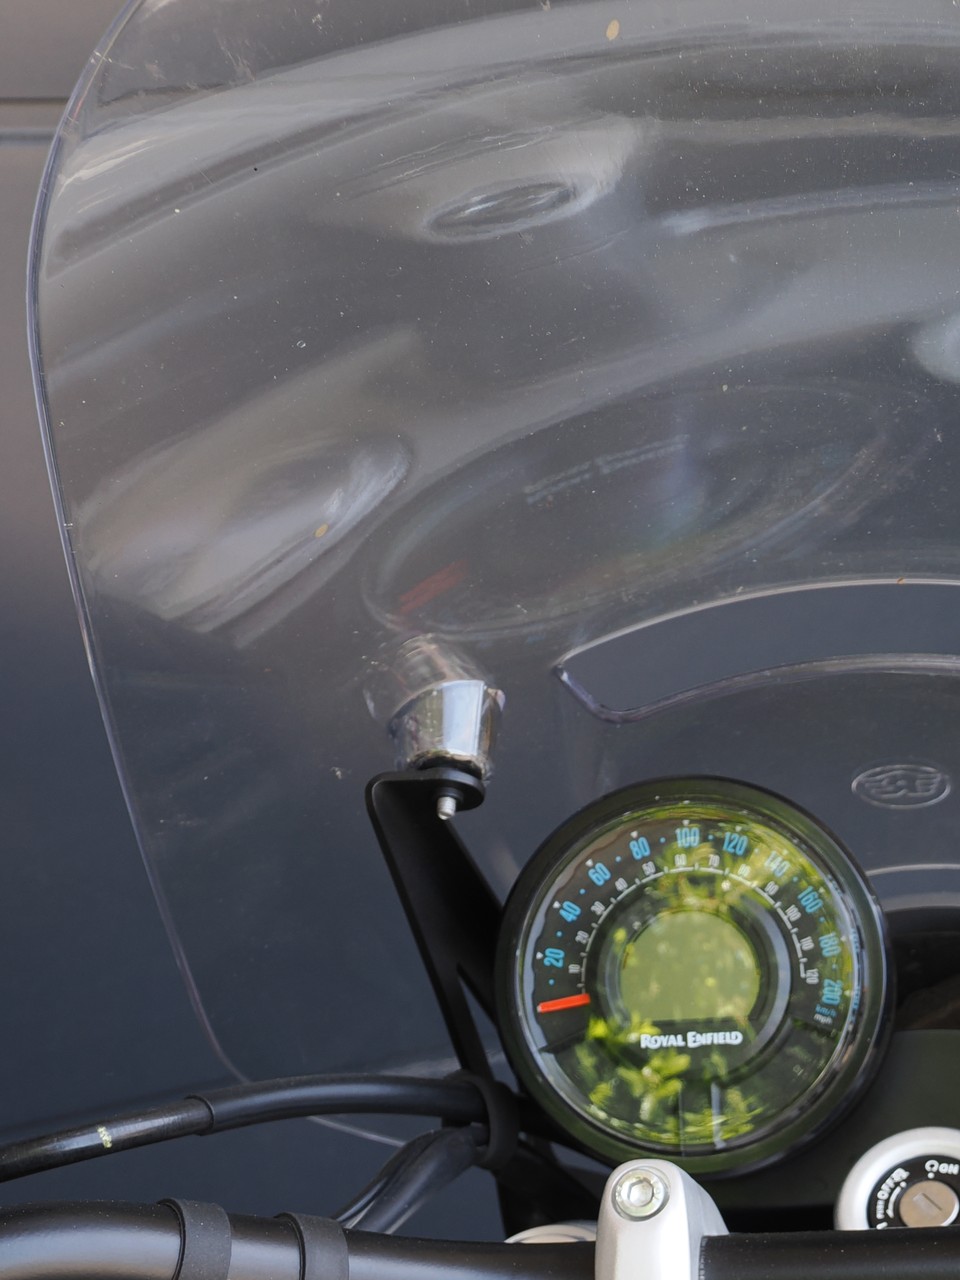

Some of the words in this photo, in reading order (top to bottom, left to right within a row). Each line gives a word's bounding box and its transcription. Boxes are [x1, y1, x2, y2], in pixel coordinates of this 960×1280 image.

[675, 828, 700, 848] 100
[722, 831, 748, 856] 120
[629, 837, 651, 860] 80
[641, 861, 656, 876] 50
[674, 853, 687, 867] 60
[708, 855, 720, 868] 70
[764, 851, 790, 877] 140
[587, 863, 612, 887] 60
[737, 864, 751, 878] 80
[614, 878, 628, 892] 40
[764, 881, 779, 896] 90
[590, 900, 606, 916] 30
[797, 886, 823, 914] 160
[559, 900, 582, 923] 40
[785, 904, 801, 923] 100
[575, 930, 590, 945] 20
[799, 936, 814, 951] 110
[818, 932, 842, 958] 180
[544, 948, 565, 968] 20
[568, 963, 581, 974] 10
[805, 968, 819, 985] 120
[821, 978, 843, 1006] 200
[640, 1033, 686, 1049] ROYAL
[686, 1031, 743, 1048] ENFIELD
[939, 1162, 960, 1175] ON
